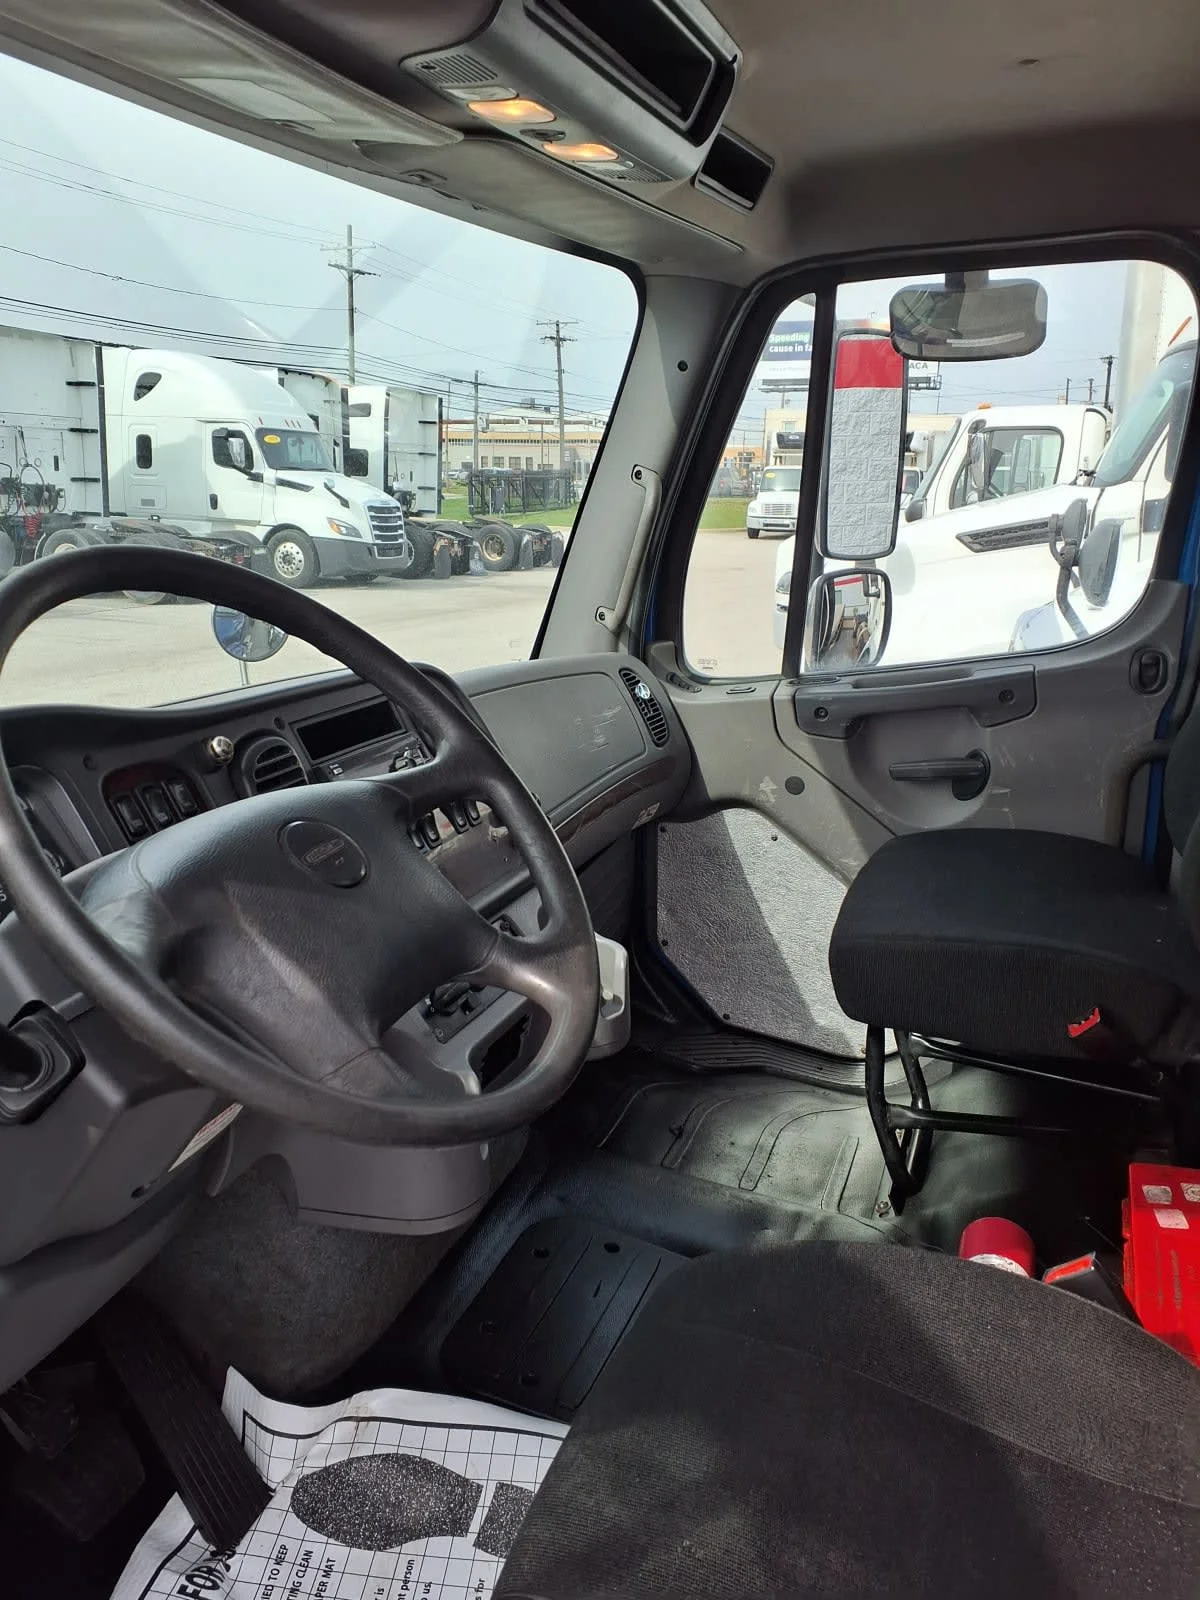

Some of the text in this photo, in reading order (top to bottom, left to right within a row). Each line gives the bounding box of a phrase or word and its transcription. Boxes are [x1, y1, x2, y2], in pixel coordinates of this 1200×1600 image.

[795, 343, 803, 352] in
[273, 1544, 288, 1566] KEEP
[295, 1550, 313, 1578] CLEAN
[268, 1568, 280, 1580] TO
[322, 1557, 336, 1578] MAT
[401, 1559, 415, 1591] person
[475, 1578, 485, 1593] for
